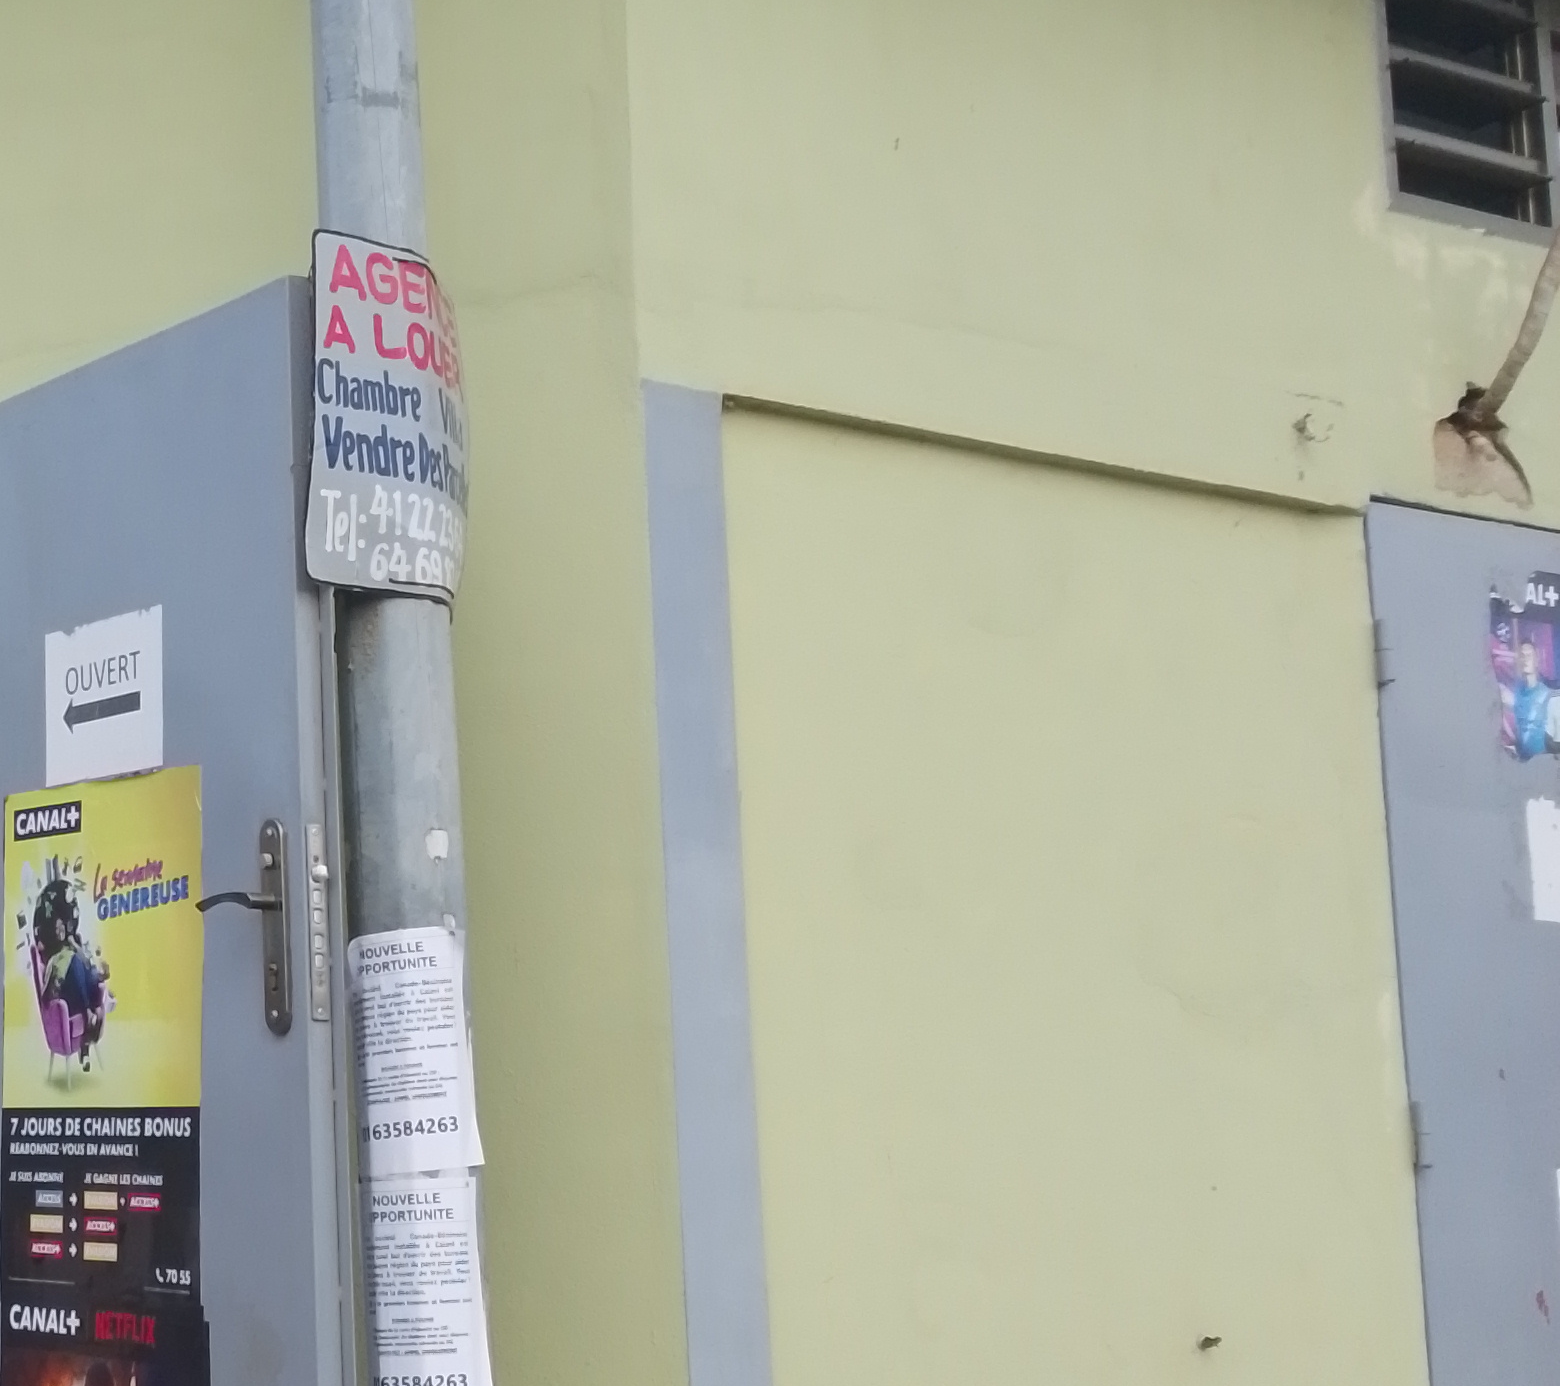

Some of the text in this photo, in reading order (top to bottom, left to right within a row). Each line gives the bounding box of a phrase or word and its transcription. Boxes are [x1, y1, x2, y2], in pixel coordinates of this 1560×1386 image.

[324, 304, 356, 353] A
[317, 358, 422, 422] Chambre
[322, 414, 415, 482] Vendre
[320, 489, 366, 561] Tel:
[370, 542, 411, 582] 64
[65, 650, 140, 695] OUVERT
[16, 805, 80, 836] CANAL+
[10, 1117, 18, 1136] 7
[21, 1117, 62, 1136] JOURS
[65, 1118, 81, 1136] DE
[144, 1116, 191, 1138] BONUS
[372, 1193, 441, 1207] NOUVELLE
[9, 1304, 156, 1346] CANAL+ NETFLIX
